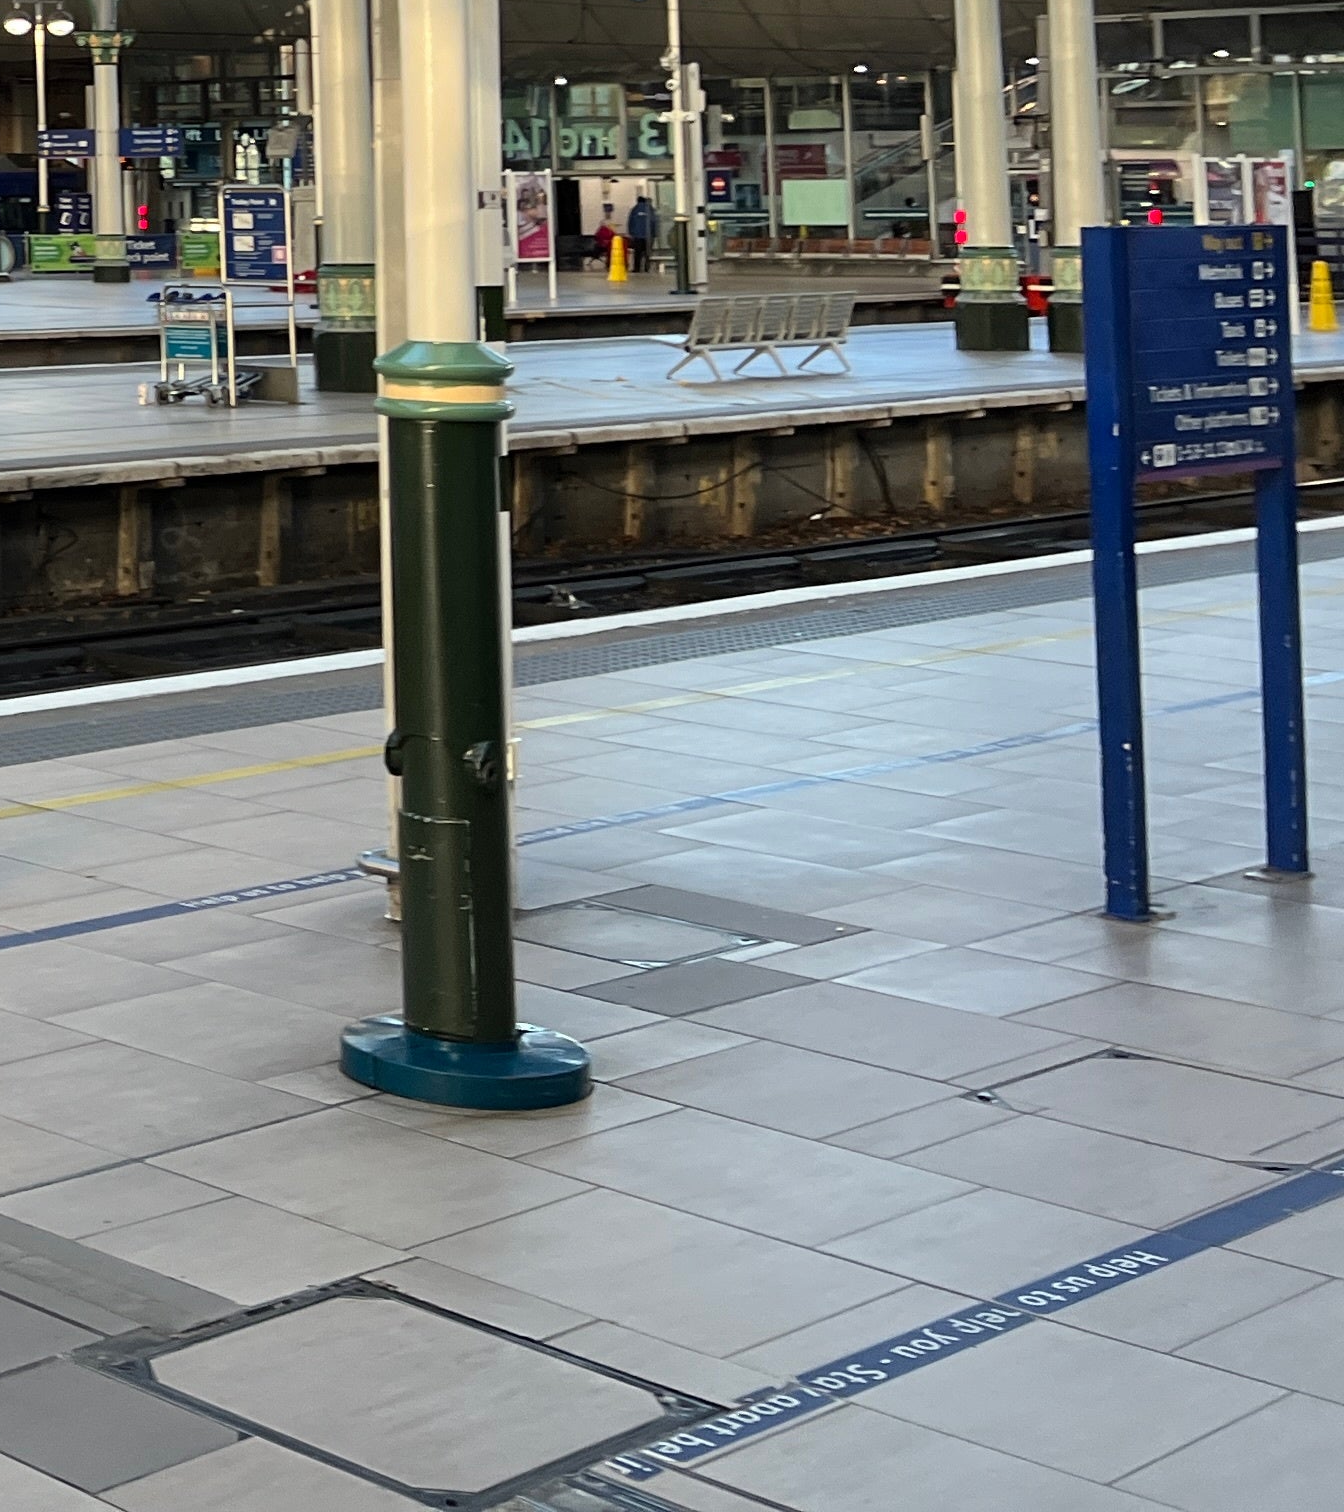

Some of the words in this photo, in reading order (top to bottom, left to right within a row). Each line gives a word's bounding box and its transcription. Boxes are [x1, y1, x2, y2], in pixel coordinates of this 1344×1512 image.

[1082, 1250, 1169, 1278] Help
[1050, 1275, 1097, 1293] us
[1017, 1290, 1068, 1306] to
[889, 1328, 961, 1360] you
